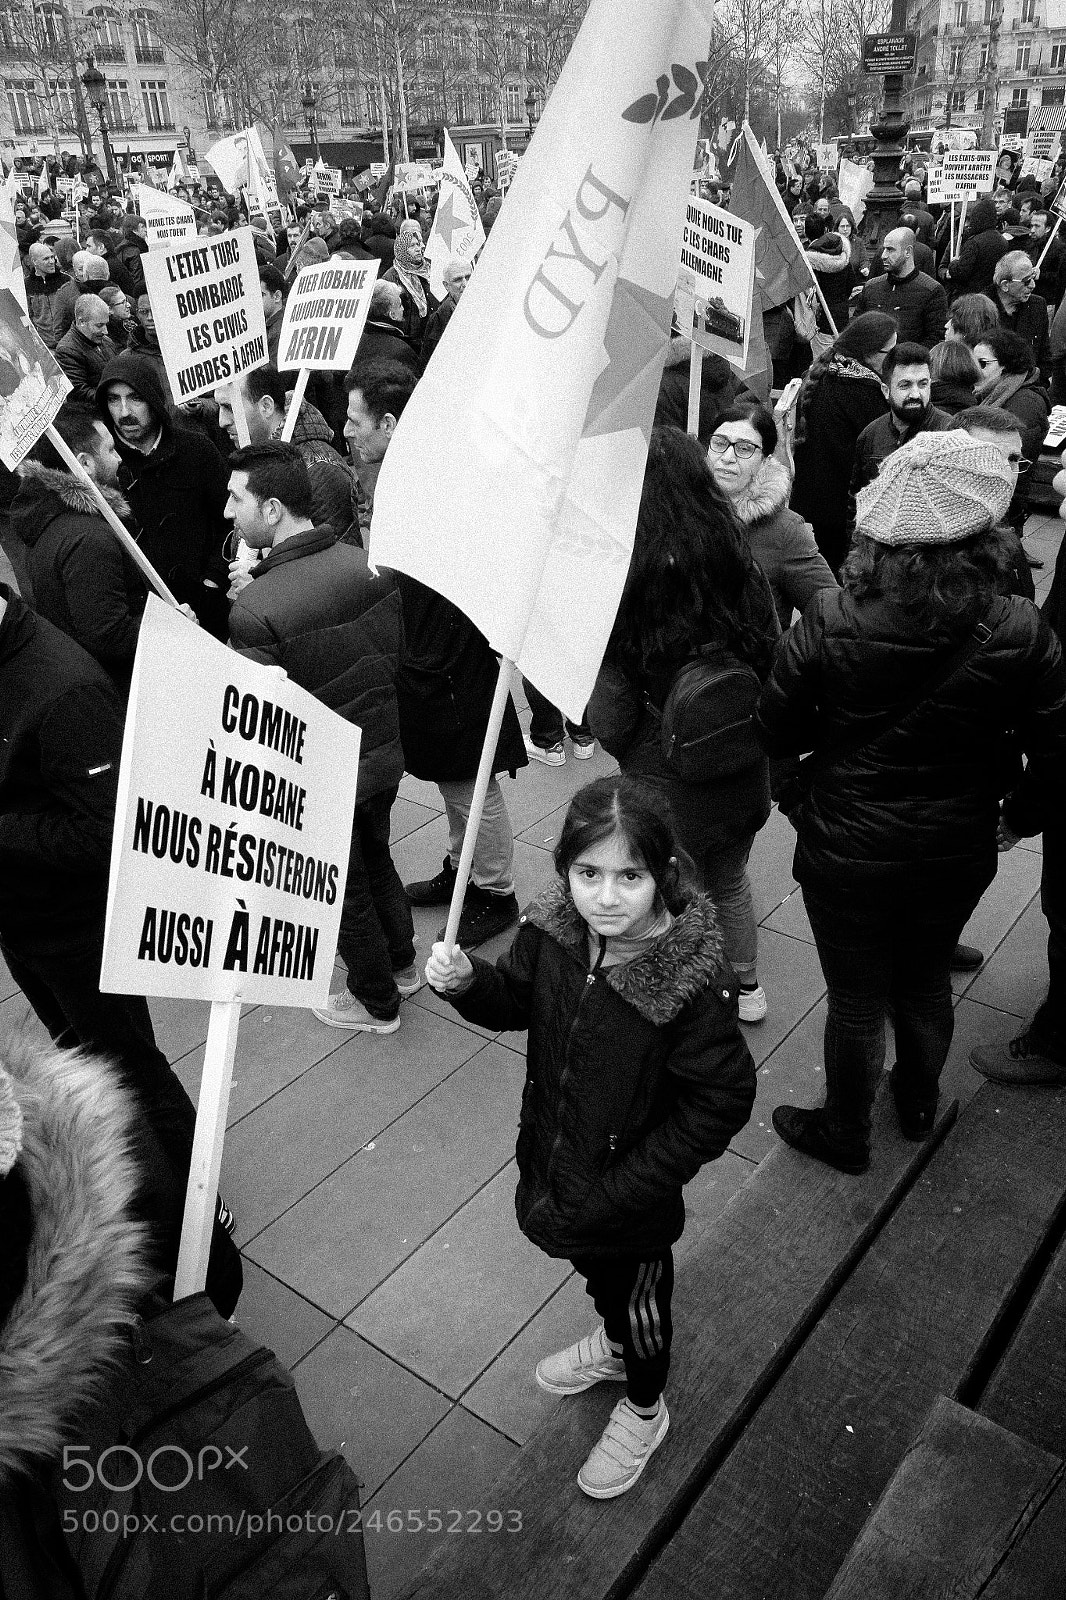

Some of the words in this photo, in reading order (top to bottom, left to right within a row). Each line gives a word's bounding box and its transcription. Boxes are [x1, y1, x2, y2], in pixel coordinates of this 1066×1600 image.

[147, 153, 168, 163] SPORT
[944, 163, 968, 171] DOIVENT
[968, 163, 993, 171] ARRÊTER
[948, 154, 959, 162] LES
[959, 152, 991, 162] ÉTATS-UNIS
[955, 173, 990, 181] MASSACRES
[955, 182, 977, 190] D'AFRIN
[169, 227, 187, 238] TUENT
[689, 229, 701, 250] LES
[701, 236, 731, 264] CHARS
[702, 213, 725, 238] NOUS
[726, 223, 743, 246] TUE
[166, 247, 210, 283] L'ETAT
[210, 238, 240, 270] TURC
[680, 248, 723, 285] ALLEMAGNE
[175, 273, 245, 319] BOMBARDE
[296, 273, 319, 295] HIER
[318, 269, 368, 290] KOBANE
[289, 298, 360, 323] AUJOURD'HUI
[186, 323, 212, 353] LES
[213, 308, 248, 344] CIVILS
[284, 326, 343, 362] AFRIN
[177, 353, 231, 396] KURDES
[231, 345, 242, 374] À
[240, 335, 265, 370] AFRIN
[221, 684, 307, 765] COMME
[200, 738, 217, 799] À
[220, 756, 307, 832] KOBANE
[132, 796, 202, 869] NOUS
[204, 821, 339, 906] RÉSISTERONS
[137, 905, 214, 968] AUSSI
[222, 897, 250, 973] À
[252, 915, 319, 981] AFRIN
